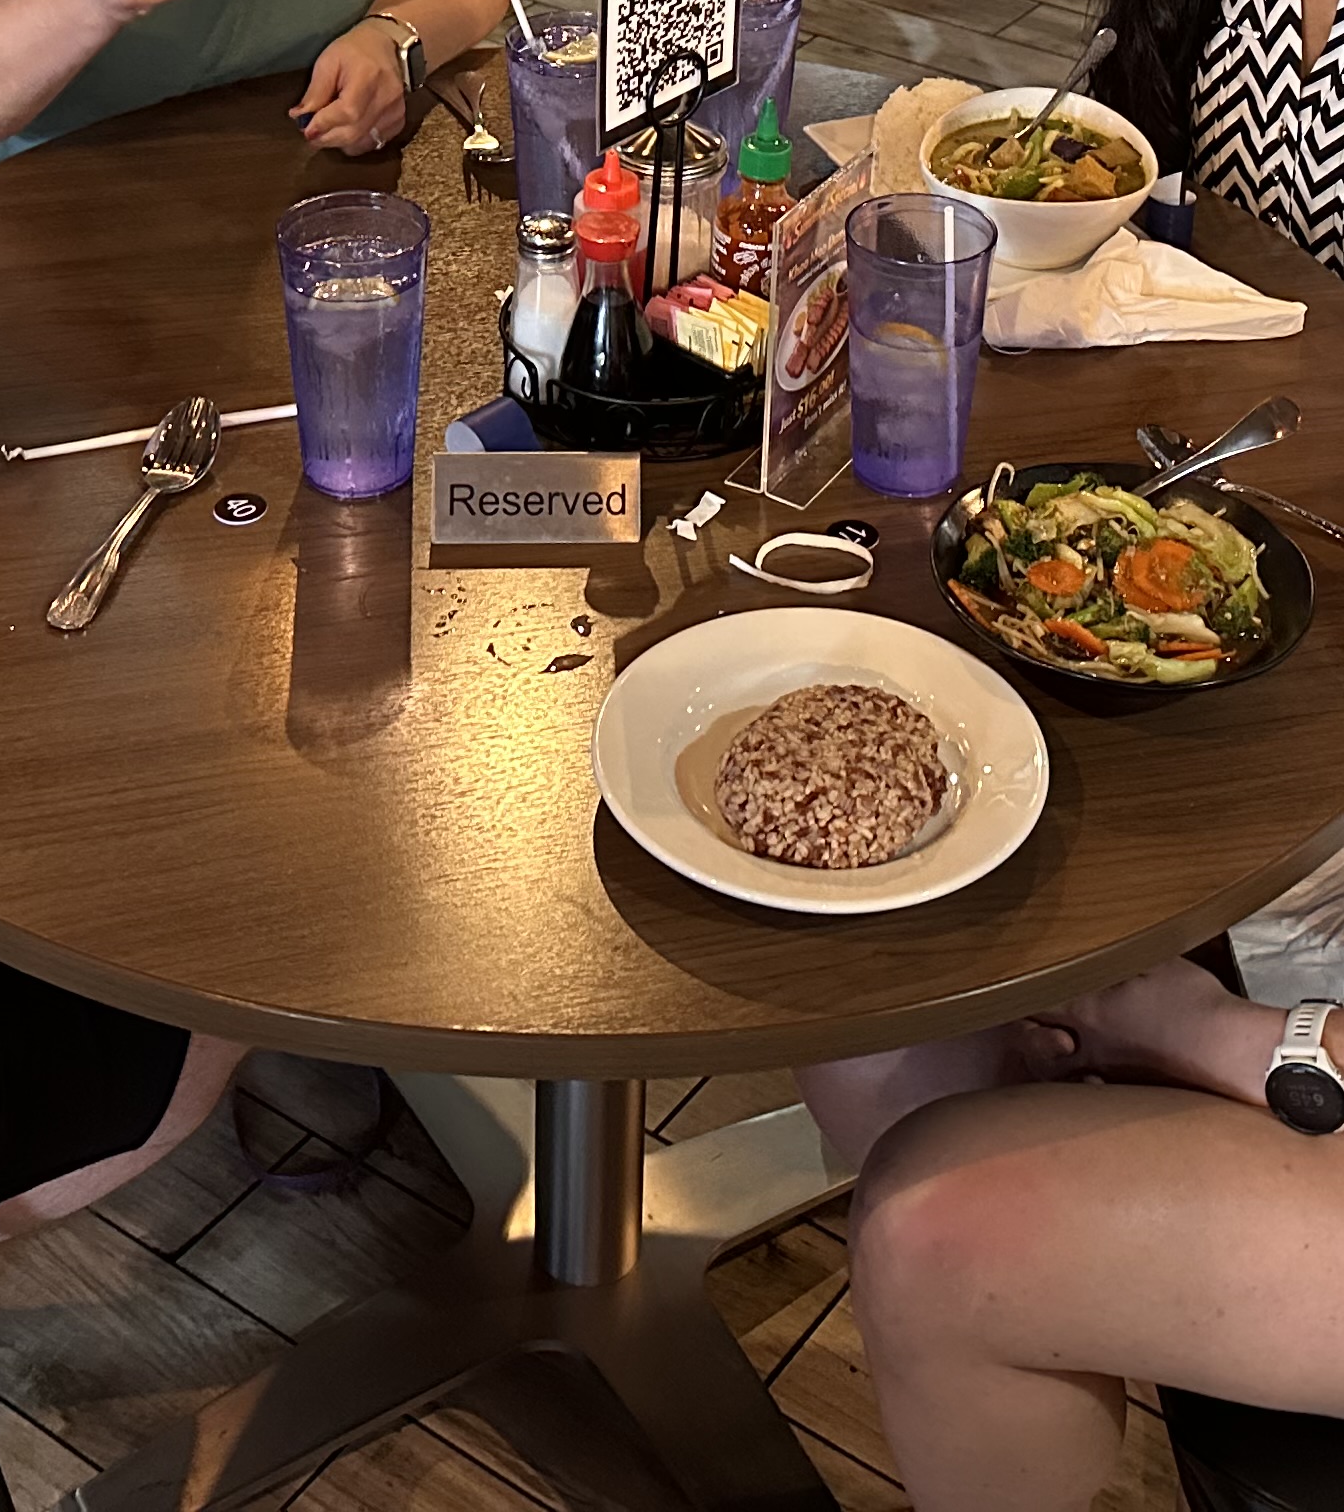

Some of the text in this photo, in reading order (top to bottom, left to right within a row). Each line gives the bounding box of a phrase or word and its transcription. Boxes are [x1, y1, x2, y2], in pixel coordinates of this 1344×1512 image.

[778, 408, 797, 435] Just
[226, 498, 257, 518] 40
[448, 482, 627, 517] Reserved
